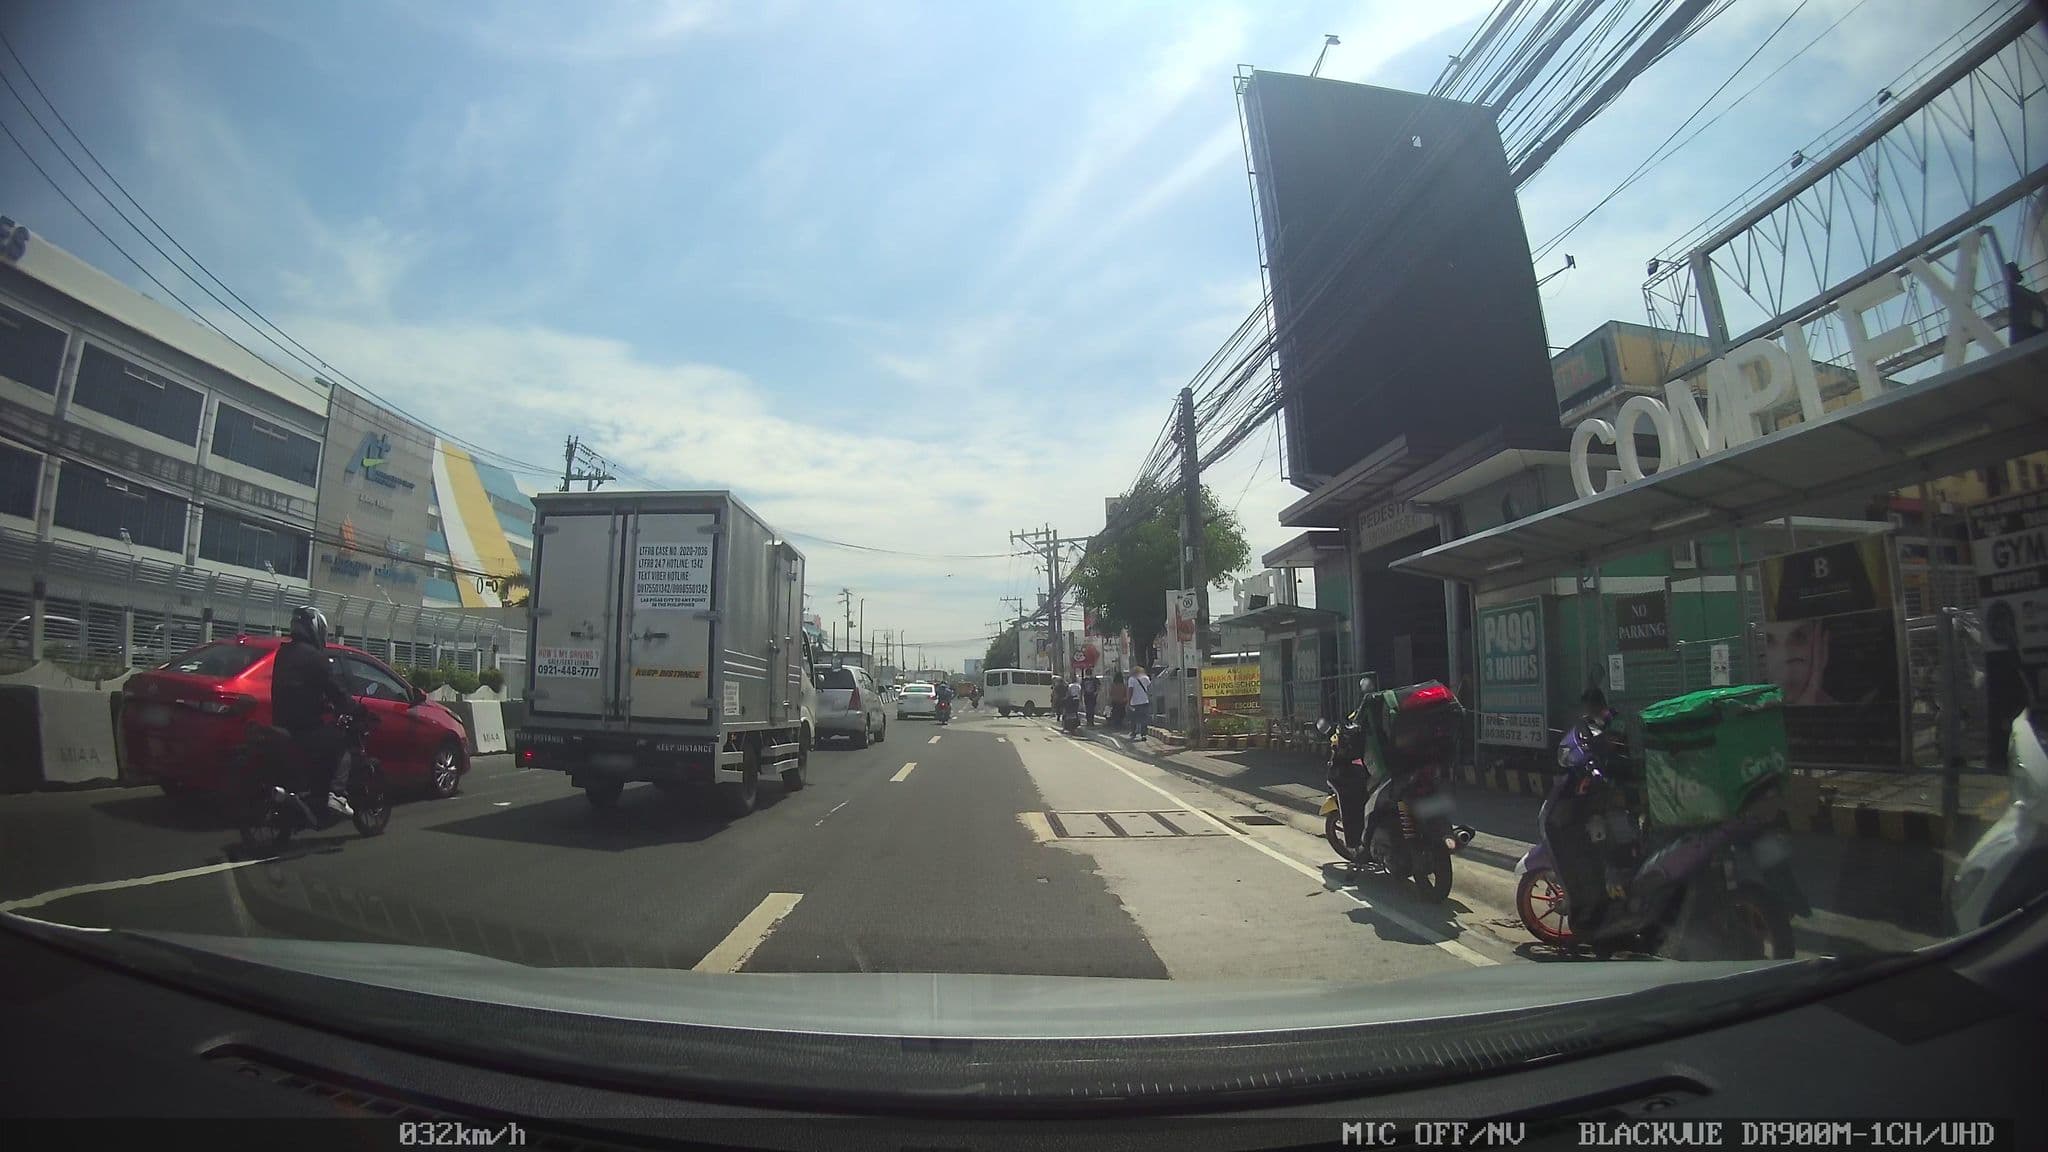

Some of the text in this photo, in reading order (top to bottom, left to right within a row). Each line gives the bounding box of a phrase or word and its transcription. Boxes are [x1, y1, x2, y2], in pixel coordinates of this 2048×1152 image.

[655, 546, 669, 556] CASE
[638, 571, 651, 581] TEXT
[1631, 603, 1648, 618] NO
[1618, 622, 1666, 640] PARKING
[538, 664, 599, 677] 0921-448-7777
[1486, 654, 1538, 681] 3 HOURS
[635, 668, 703, 679] KEEP DISTANCE
[1204, 682, 1234, 690] DRIVING
[677, 744, 713, 753] DISTANCE
